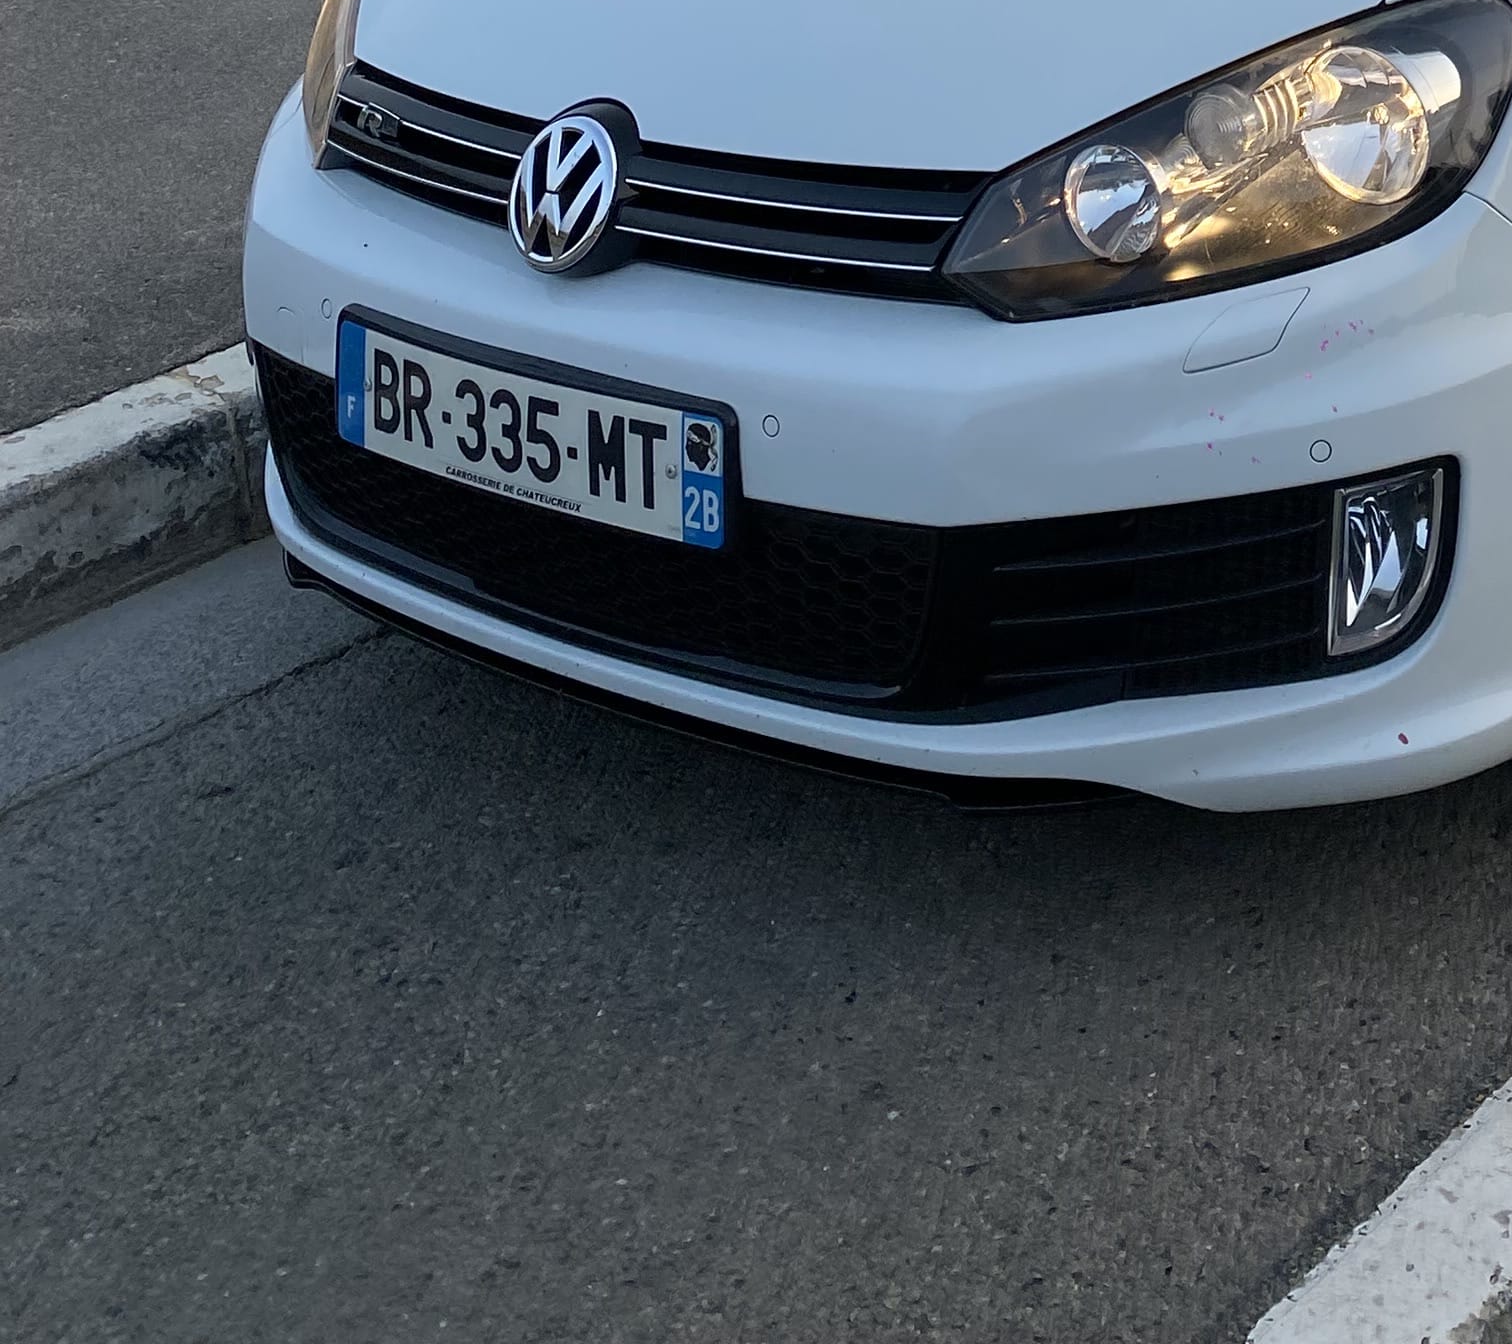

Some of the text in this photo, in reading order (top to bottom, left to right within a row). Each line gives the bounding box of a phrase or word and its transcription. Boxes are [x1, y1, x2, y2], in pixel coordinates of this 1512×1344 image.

[347, 395, 356, 419] F
[374, 348, 668, 510] BR-335-MT
[445, 466, 502, 490] CARROSSERIE
[503, 483, 515, 496] DE
[684, 486, 721, 533] 2B
